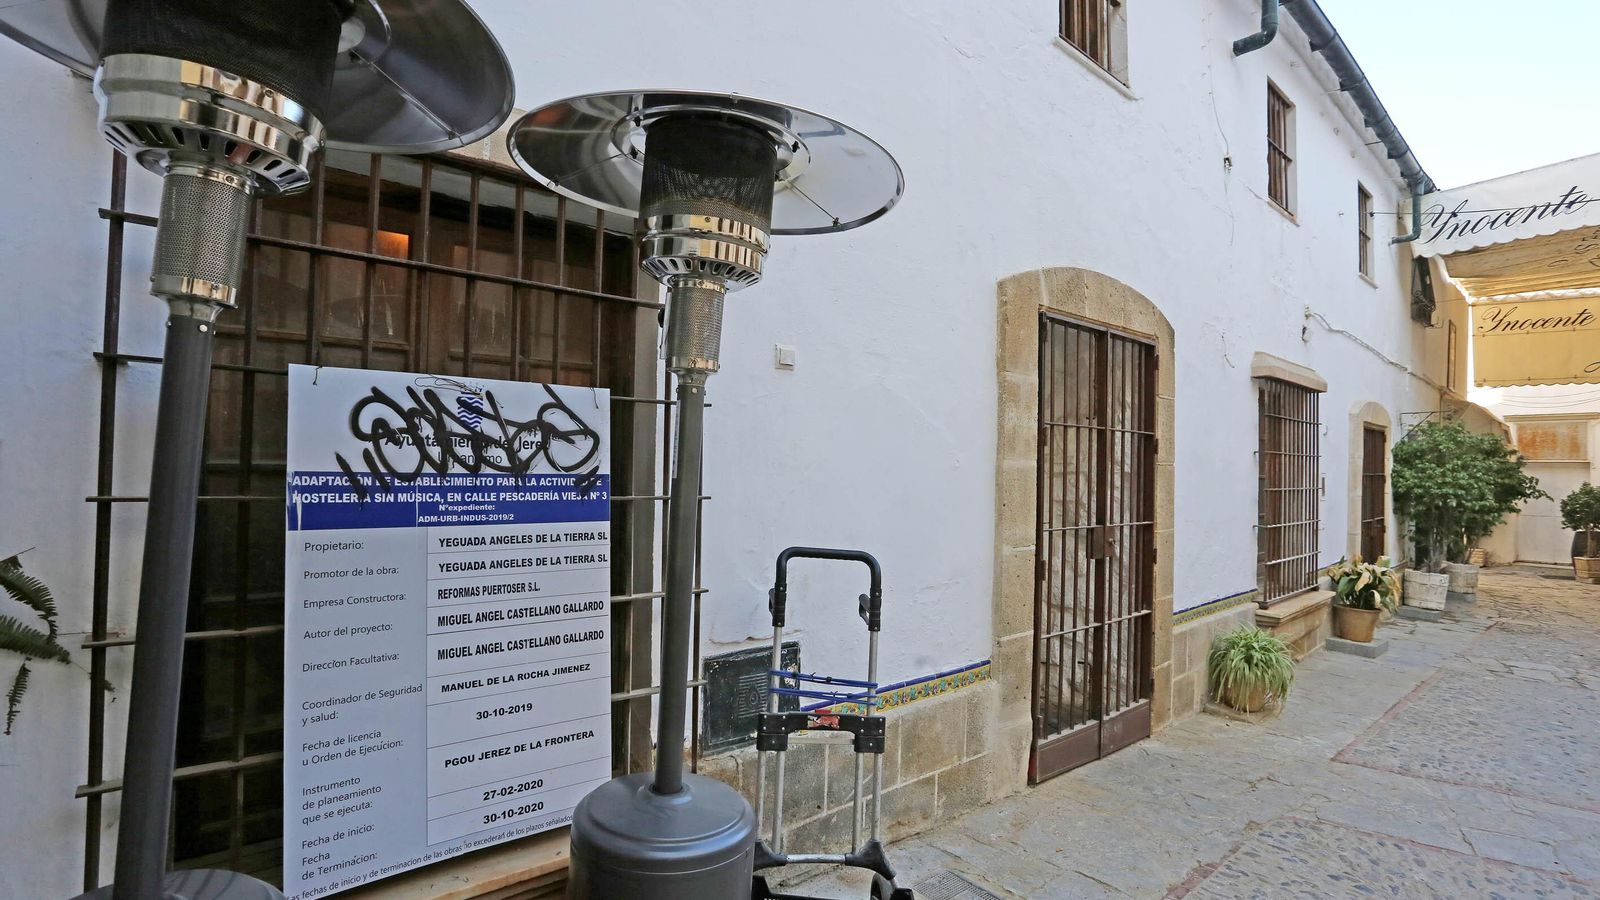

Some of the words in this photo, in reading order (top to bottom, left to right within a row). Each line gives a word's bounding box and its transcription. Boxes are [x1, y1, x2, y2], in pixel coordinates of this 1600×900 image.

[1420, 185, 1594, 244] Ynocente
[1478, 306, 1596, 333] Ynocente
[516, 436, 549, 453] Jere
[292, 474, 372, 486] ADAPTACÓN
[496, 477, 522, 487] PARA
[526, 477, 537, 486] LA
[539, 477, 589, 487] ACTIVID
[292, 493, 371, 503] HOSTELERA
[374, 493, 394, 503] SIN
[398, 491, 444, 504] MÚSICA,
[447, 493, 461, 502] EN
[465, 492, 497, 502] CALLE
[500, 490, 559, 501] PESCADERÍA
[602, 491, 608, 500] 3
[418, 514, 514, 523] ADM-URB-INDUS-2019/2
[304, 540, 364, 553] Propietario:
[438, 536, 487, 547] YEGUADA
[489, 534, 533, 546] ANGELES
[535, 533, 547, 543] DE
[550, 533, 561, 542] LA
[564, 532, 595, 542] TIERRA
[597, 531, 608, 540] SL
[303, 569, 349, 579] Promotor
[351, 567, 364, 577] de
[366, 567, 374, 576] la
[376, 566, 399, 575] obra:
[438, 561, 487, 573] YEGUADA
[489, 558, 533, 569] ANGELES
[535, 557, 547, 566] DE
[550, 556, 561, 565] LA
[564, 554, 595, 564] TIERRA
[597, 554, 608, 562] SL
[437, 586, 480, 599] REFORMAS
[482, 582, 526, 596] PUERTOSER
[527, 581, 541, 592] S.L.
[303, 598, 344, 609] Empresa
[346, 593, 406, 605] Constructora:
[437, 613, 473, 627] MIGUEL
[475, 610, 504, 623] ANGEL
[507, 604, 561, 620] CASTELLANO
[563, 600, 604, 614] GALLARDO
[303, 629, 331, 639] Autor
[333, 626, 348, 636] del
[350, 623, 393, 636] proyecto:
[437, 646, 473, 661] MIGUEL
[475, 642, 504, 655] ANGEL
[507, 635, 561, 651] CASTELLANO
[563, 630, 604, 644] GALLARDO
[349, 653, 400, 666] Facultativa:
[441, 679, 484, 693] MANUEL
[487, 677, 500, 686] DE
[502, 674, 514, 683] LA
[517, 670, 550, 681] ROCHA
[552, 663, 591, 676] JIMENEZ
[302, 694, 361, 710] Coordinador
[364, 691, 376, 700] de
[378, 684, 423, 698] Seguridad
[301, 718, 308, 727] y
[310, 711, 339, 724] salud:
[476, 702, 533, 720] 30-10-2019
[302, 741, 330, 752] Fecha
[333, 736, 345, 746] de
[348, 730, 381, 743] licencia
[444, 755, 475, 768] PGOU
[478, 747, 511, 761] JEREZ
[514, 744, 527, 753] DE
[530, 741, 542, 750] LA
[544, 730, 594, 747] FRONTERA
[311, 752, 342, 764] Orden
[344, 748, 356, 757] de
[302, 777, 361, 796] Instrumento
[482, 779, 543, 801] 27-02-2020
[302, 801, 315, 810] de
[317, 785, 382, 809] planeamiento
[302, 814, 321, 826] que
[324, 811, 334, 820] se
[337, 800, 373, 816] ejecuta:
[483, 801, 544, 824] 30-10-2020
[302, 836, 330, 849] Fecha
[332, 831, 345, 841] de
[347, 823, 375, 837] inicio:
[302, 852, 330, 866] Fecha
[302, 886, 327, 899] fechas
[329, 882, 339, 891] de
[340, 874, 361, 887] inicio
[362, 873, 368, 882] y
[369, 869, 379, 878] de
[423, 852, 432, 862] de
[433, 850, 443, 859] las
[444, 845, 463, 856] obras
[506, 829, 515, 838] de
[515, 826, 525, 836] los
[525, 823, 545, 836] plazos
[301, 869, 315, 880] de
